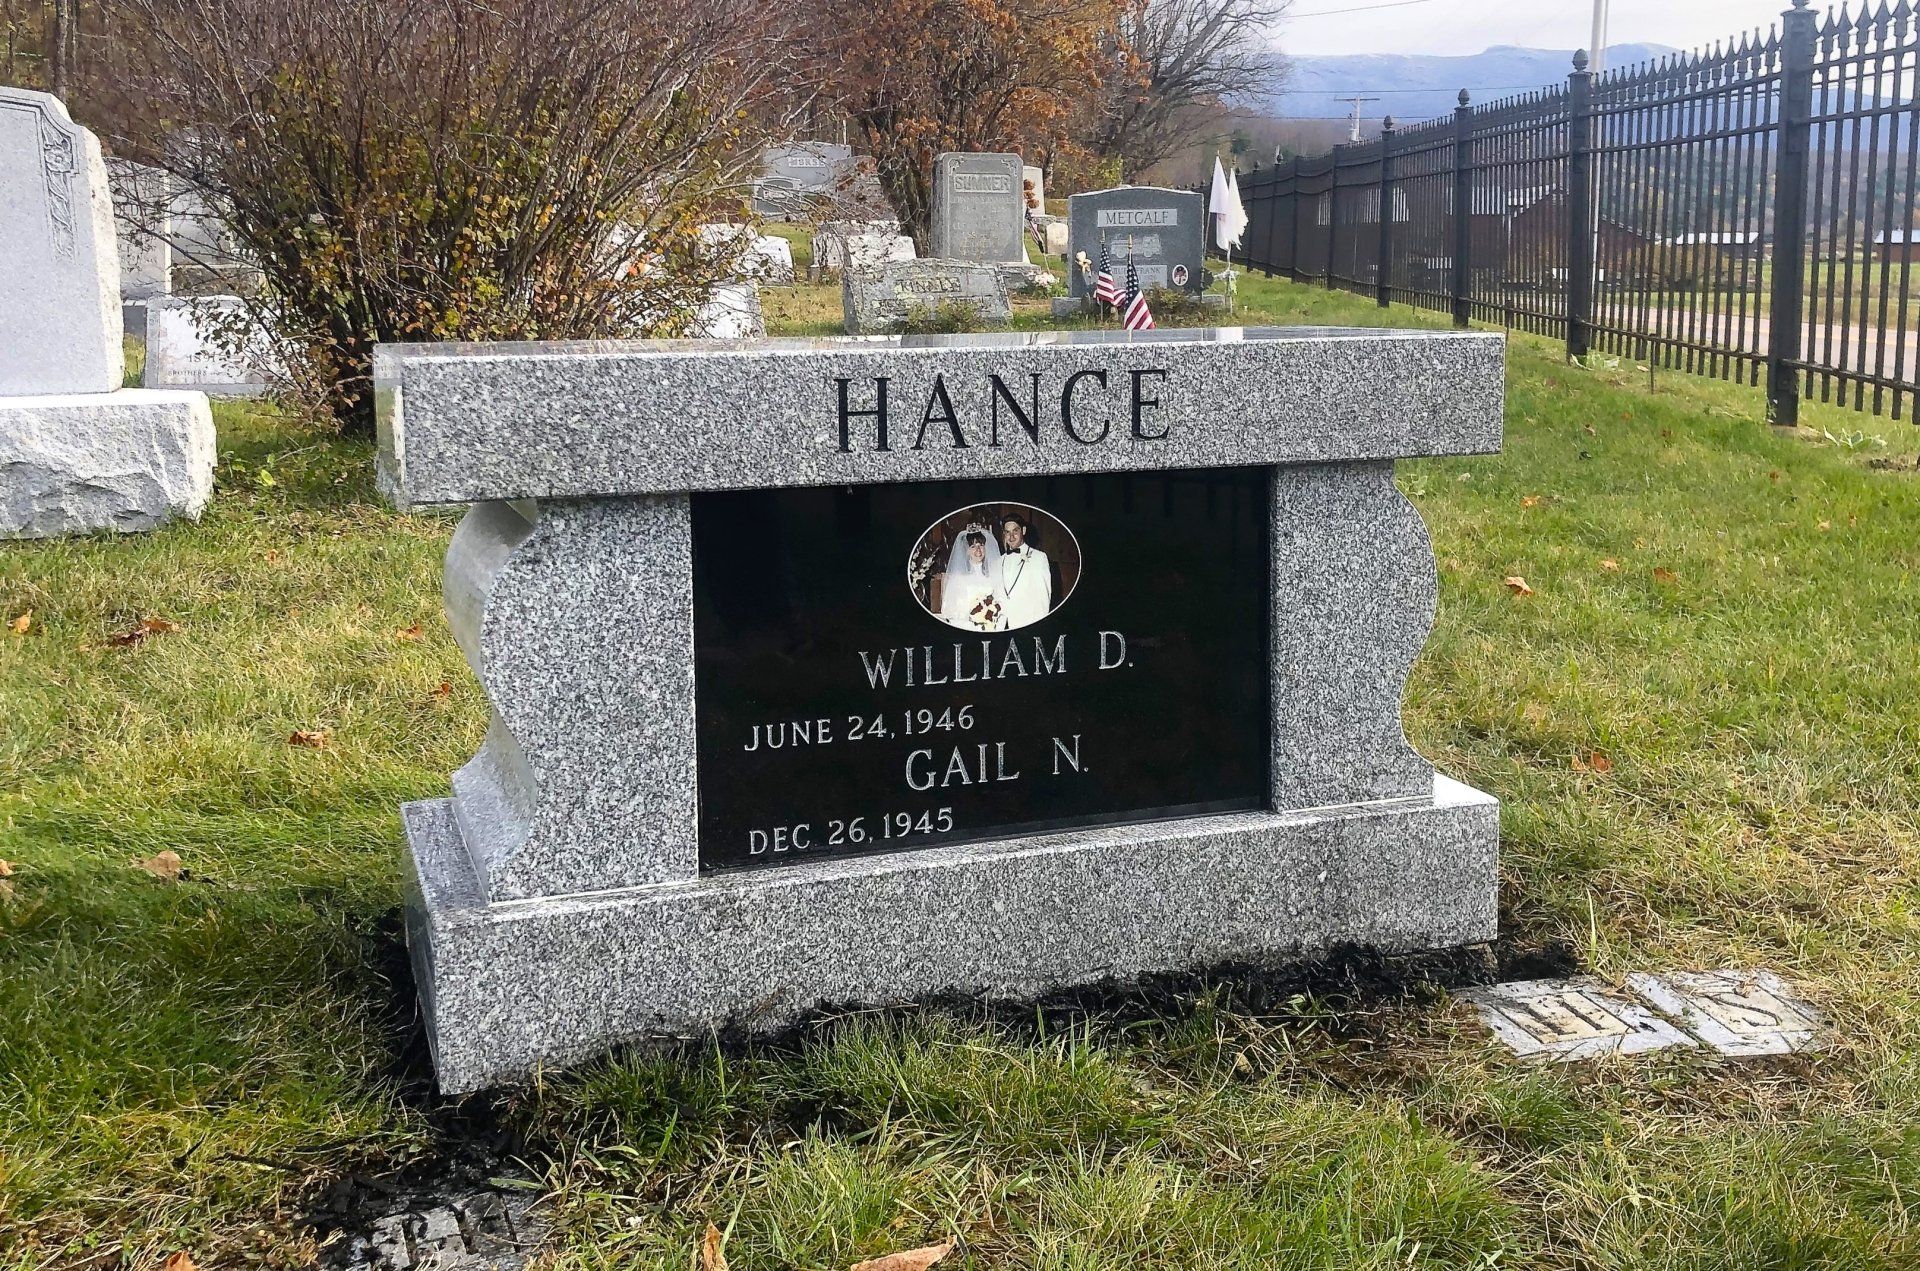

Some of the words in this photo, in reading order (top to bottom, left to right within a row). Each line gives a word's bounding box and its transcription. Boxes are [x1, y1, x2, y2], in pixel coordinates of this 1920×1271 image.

[1106, 211, 1169, 225] METCALF
[834, 368, 1170, 453] HANCE
[858, 634, 1067, 690] WILLIAM
[1098, 630, 1134, 670] D.
[744, 718, 834, 751] JUNE
[905, 742, 1020, 791] GAIL
[1052, 734, 1089, 775] N.
